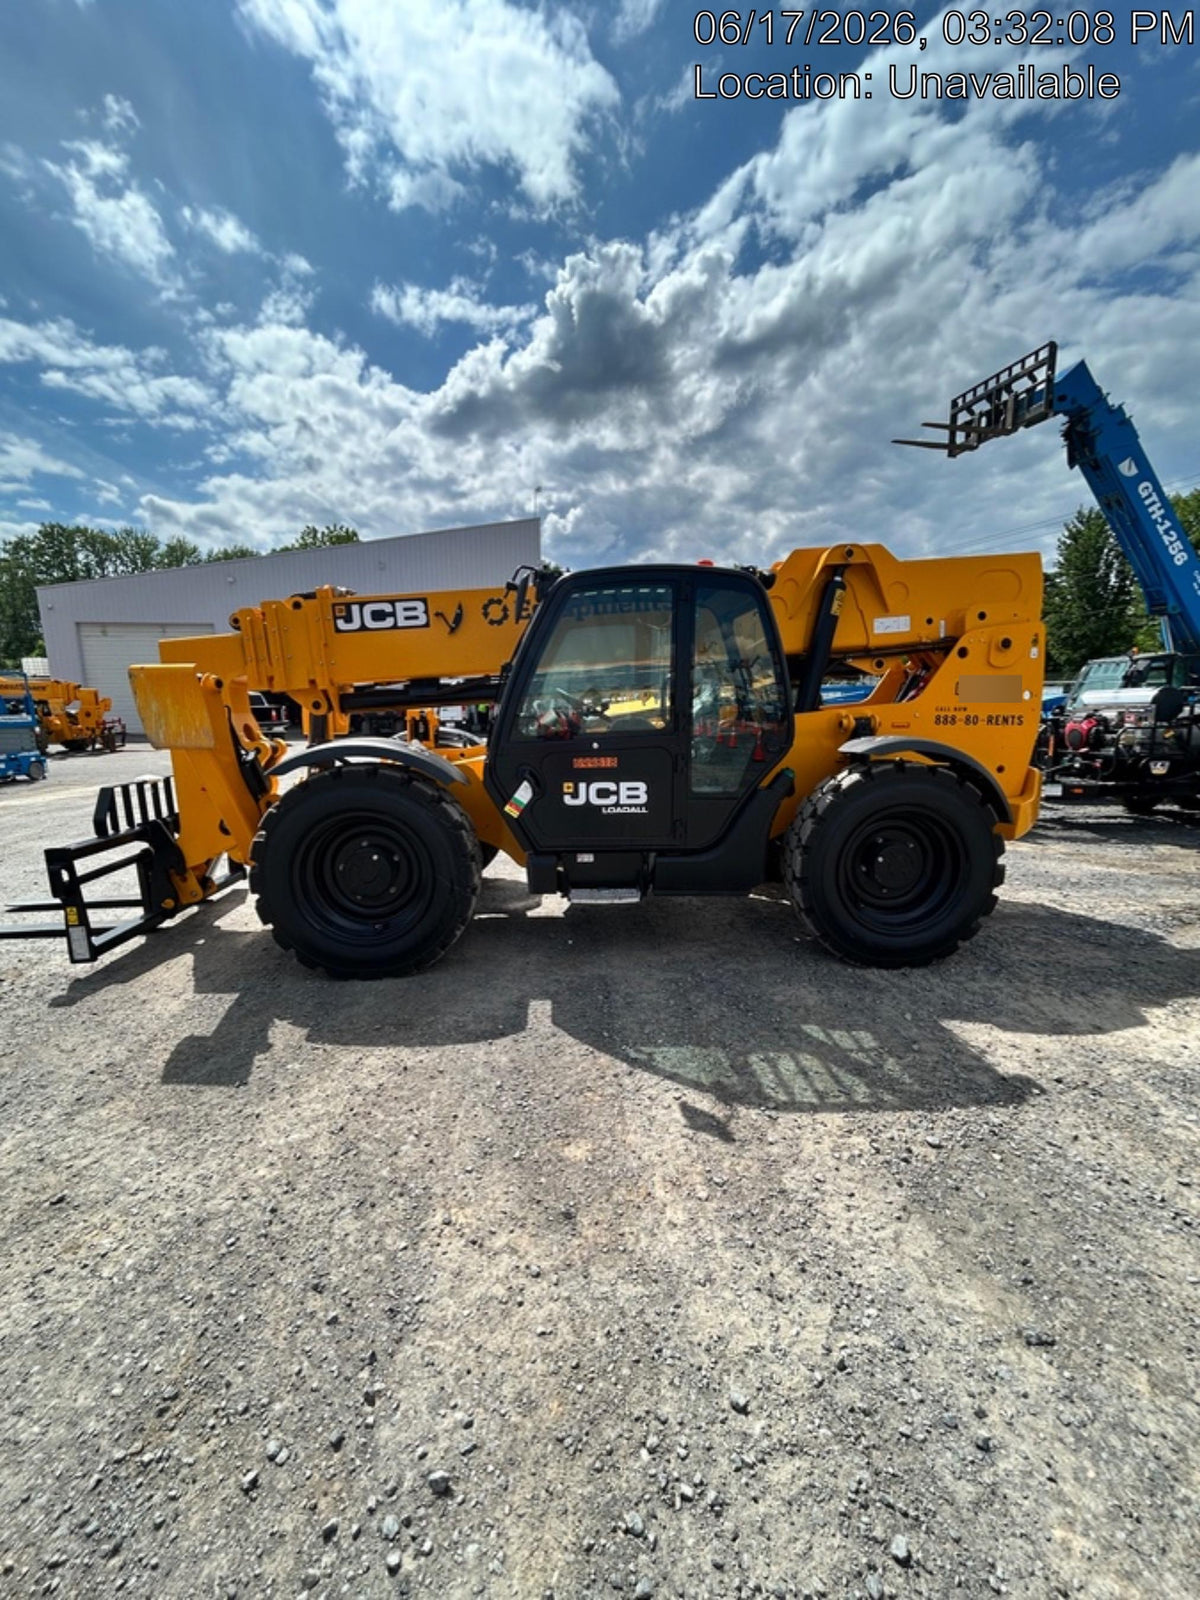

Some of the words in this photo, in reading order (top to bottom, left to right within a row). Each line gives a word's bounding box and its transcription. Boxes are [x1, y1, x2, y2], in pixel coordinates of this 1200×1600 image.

[1138, 481, 1188, 566] GTH-1256
[335, 600, 428, 631] JCB
[934, 714, 1024, 726] 888-80-RENTS
[563, 782, 648, 806] JCB
[602, 806, 648, 814] LOADALL
